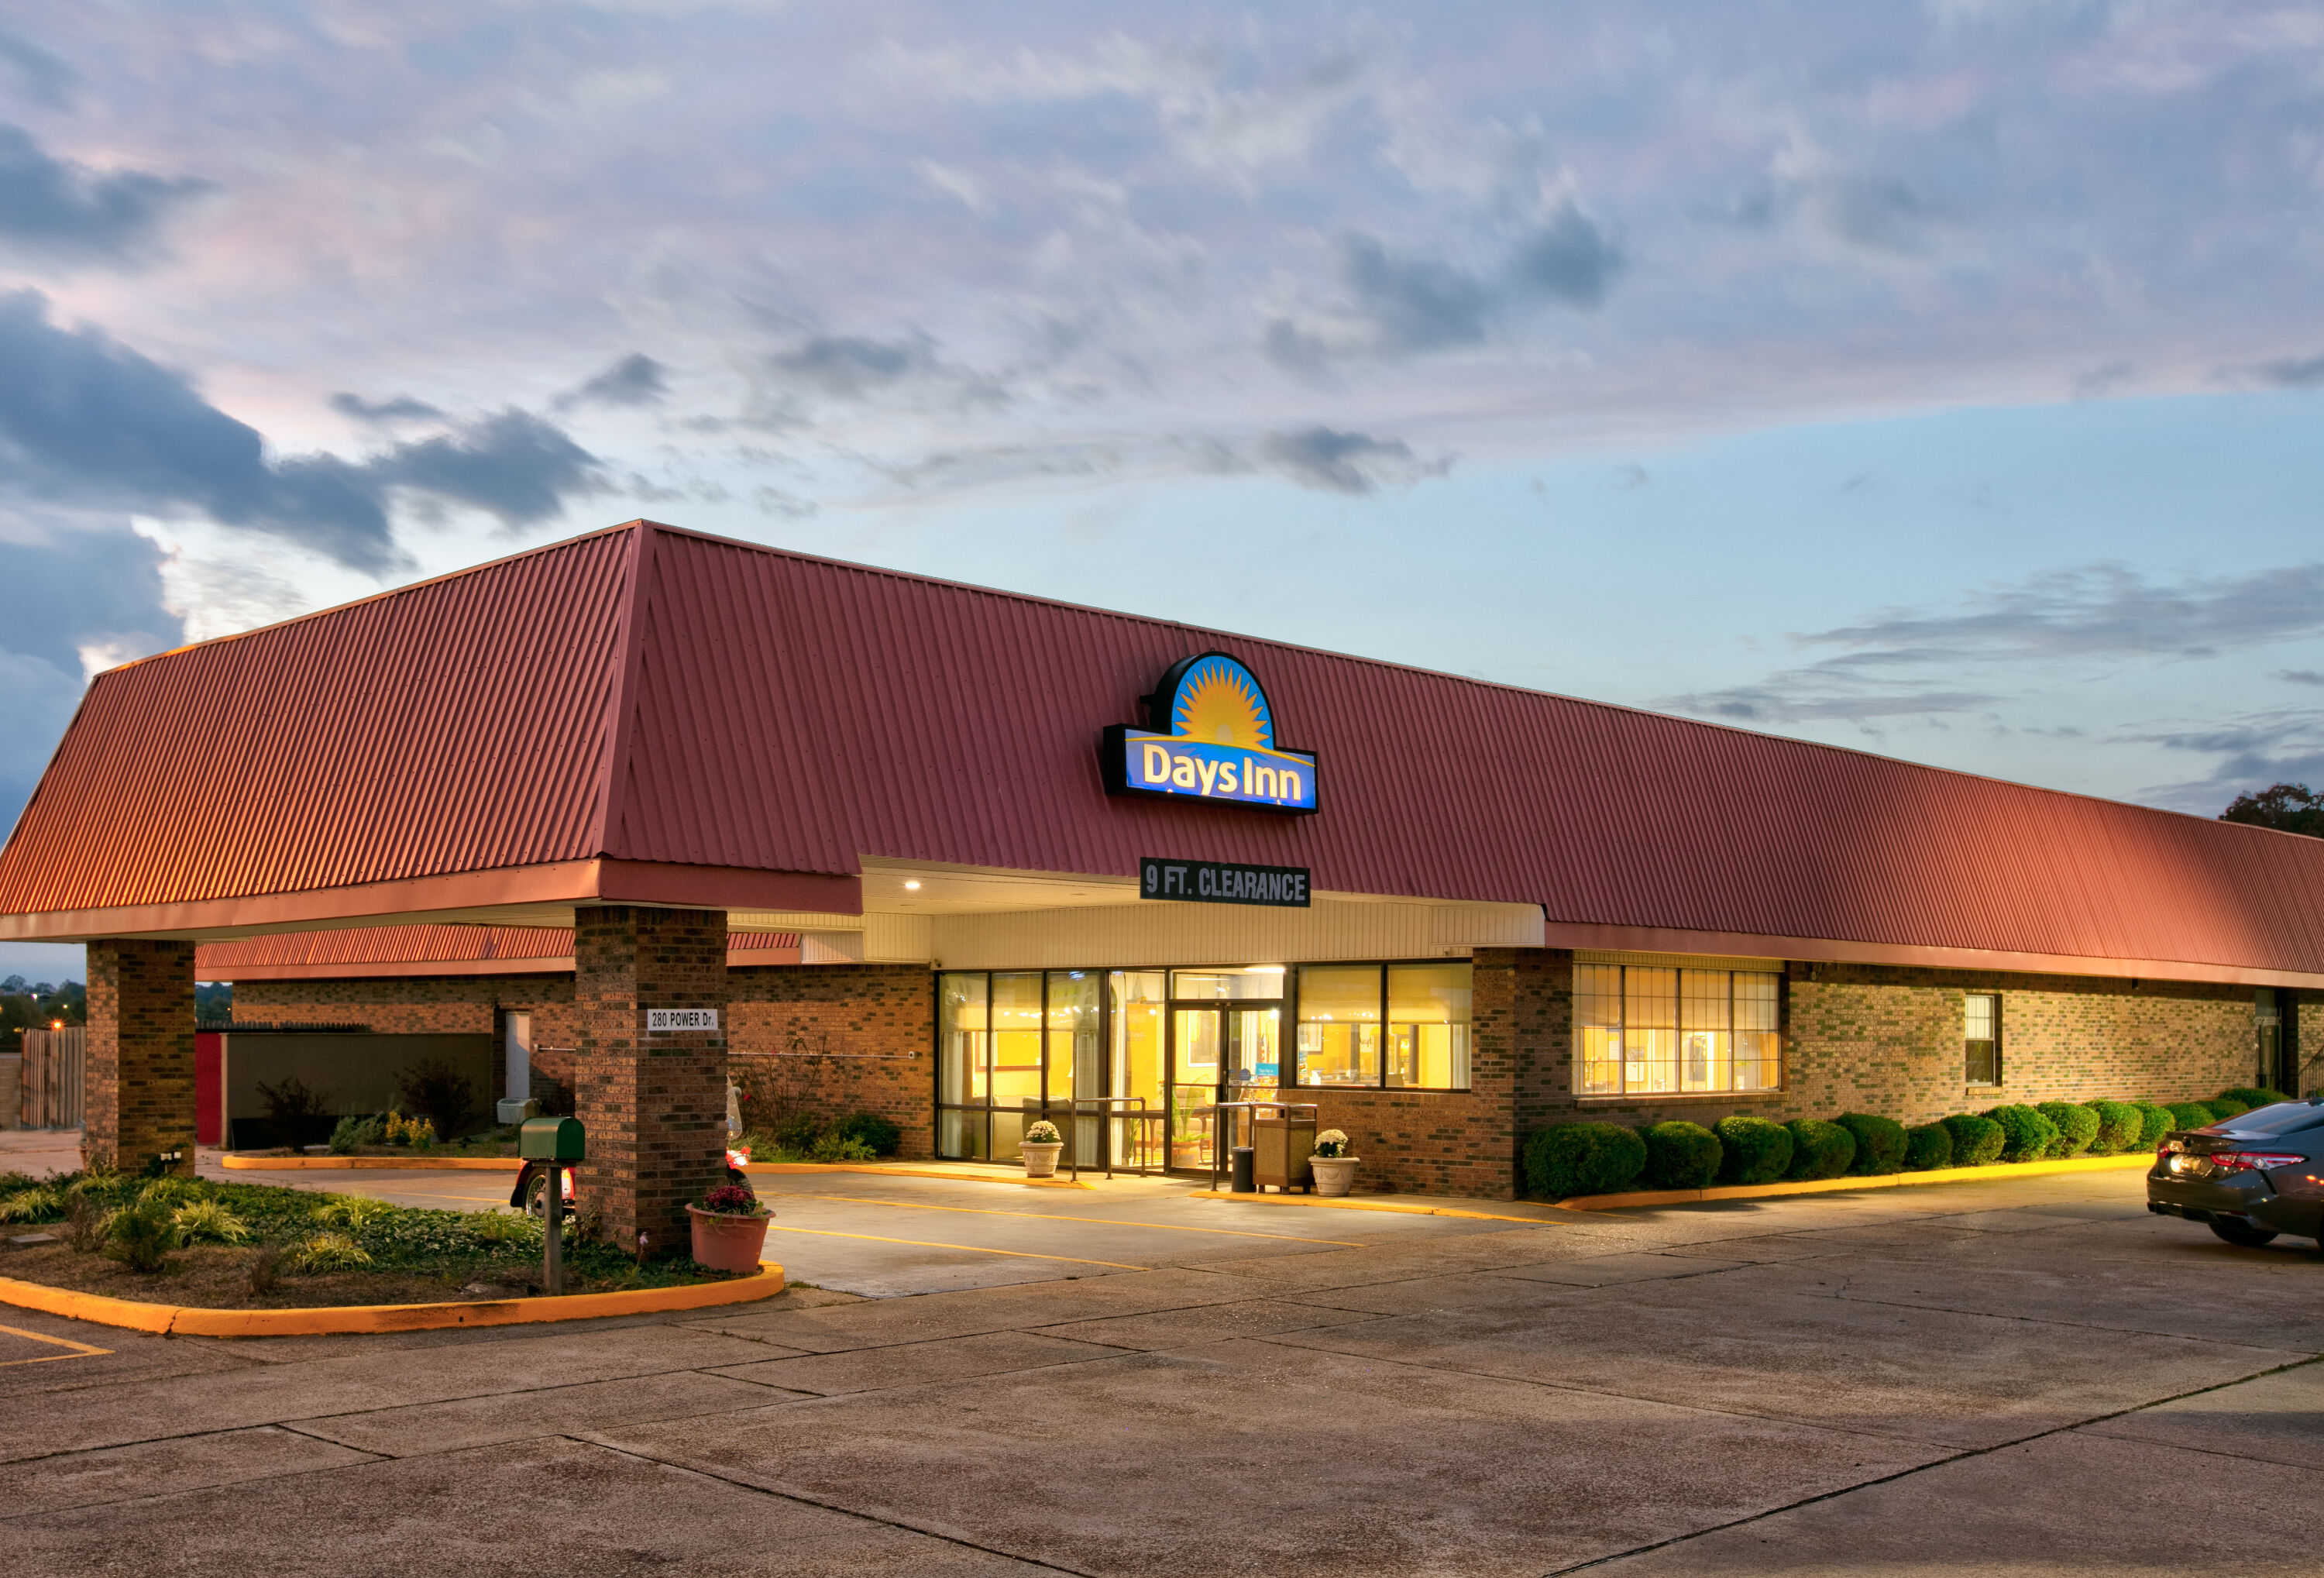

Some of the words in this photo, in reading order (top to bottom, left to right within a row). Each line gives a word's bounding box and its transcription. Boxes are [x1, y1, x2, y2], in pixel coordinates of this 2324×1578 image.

[1143, 743, 1238, 796] Days
[1243, 757, 1301, 800] Inn
[1146, 865, 1158, 893] 9
[1164, 865, 1192, 895] FT.
[1198, 868, 1305, 901] CLEARANCE
[652, 1012, 667, 1027] 280
[670, 1012, 700, 1026] POWER
[703, 1012, 714, 1026] Dr.
